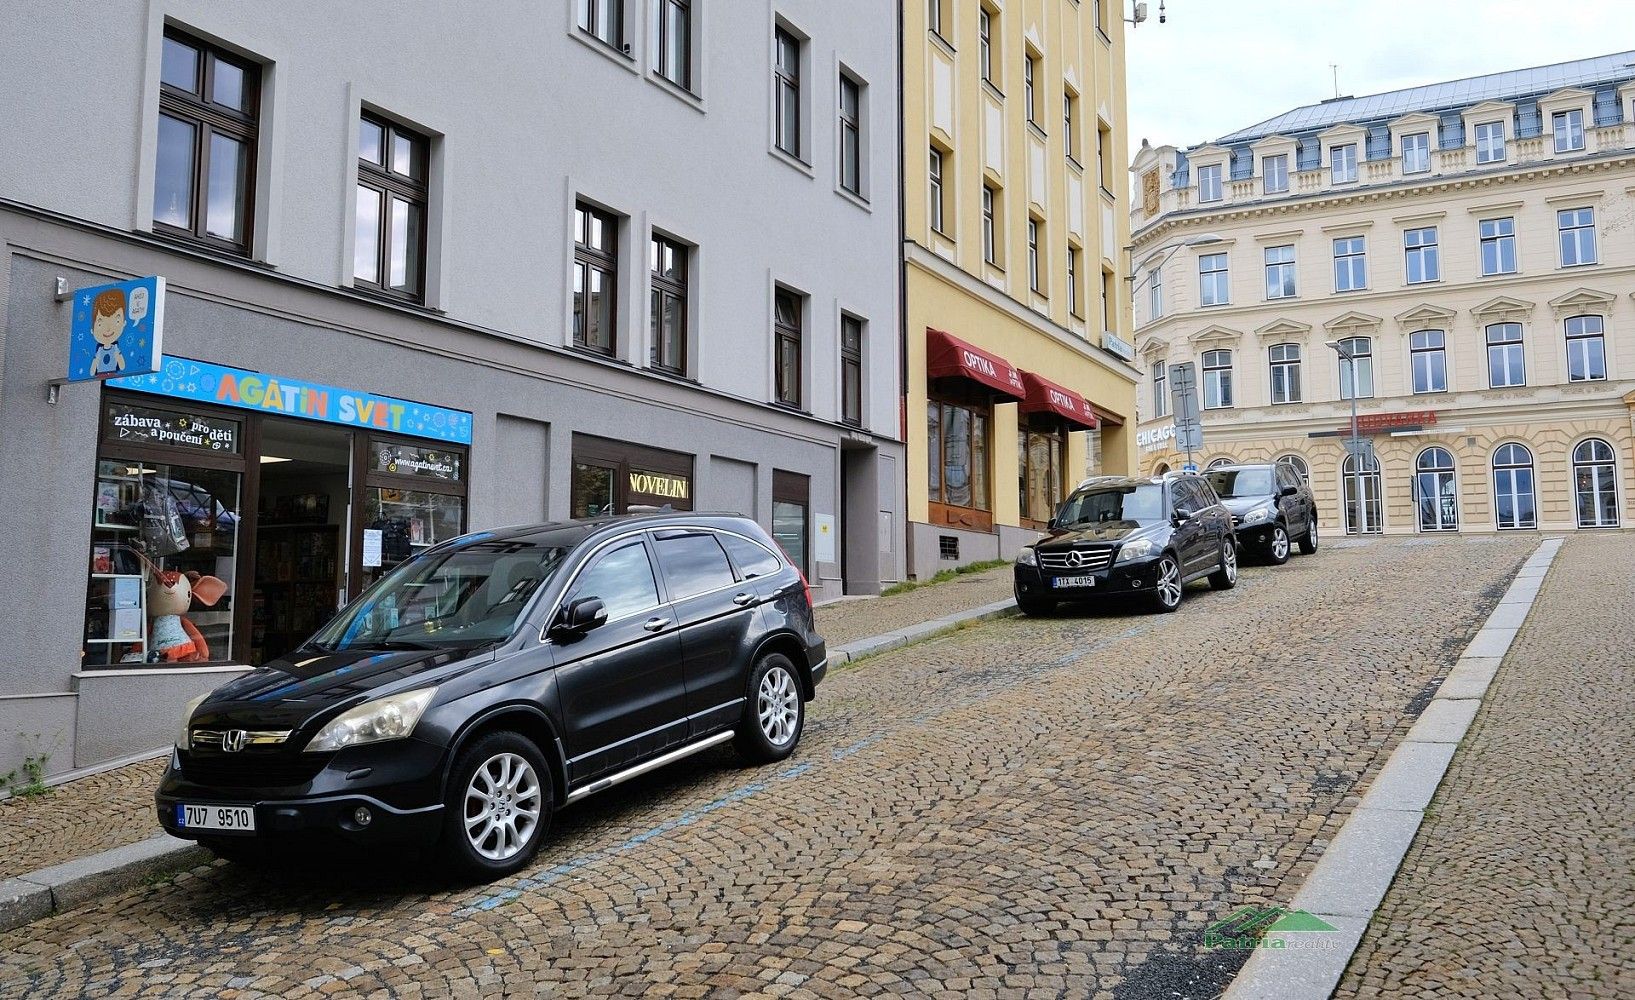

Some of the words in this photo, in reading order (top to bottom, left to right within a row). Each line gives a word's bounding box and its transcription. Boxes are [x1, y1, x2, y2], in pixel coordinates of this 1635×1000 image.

[964, 350, 997, 378] OPTIKA
[1050, 390, 1076, 411] OPTIKA
[114, 414, 161, 428] zábava
[190, 421, 210, 434] pro
[209, 428, 232, 441] děti
[150, 428, 158, 437] a
[158, 430, 203, 445] poučení
[1136, 424, 1176, 447] CHICAGO
[1057, 577, 1070, 586] 1TX
[1074, 576, 1092, 585] 4015
[186, 807, 208, 826] 7U7
[217, 808, 249, 828] 9510
